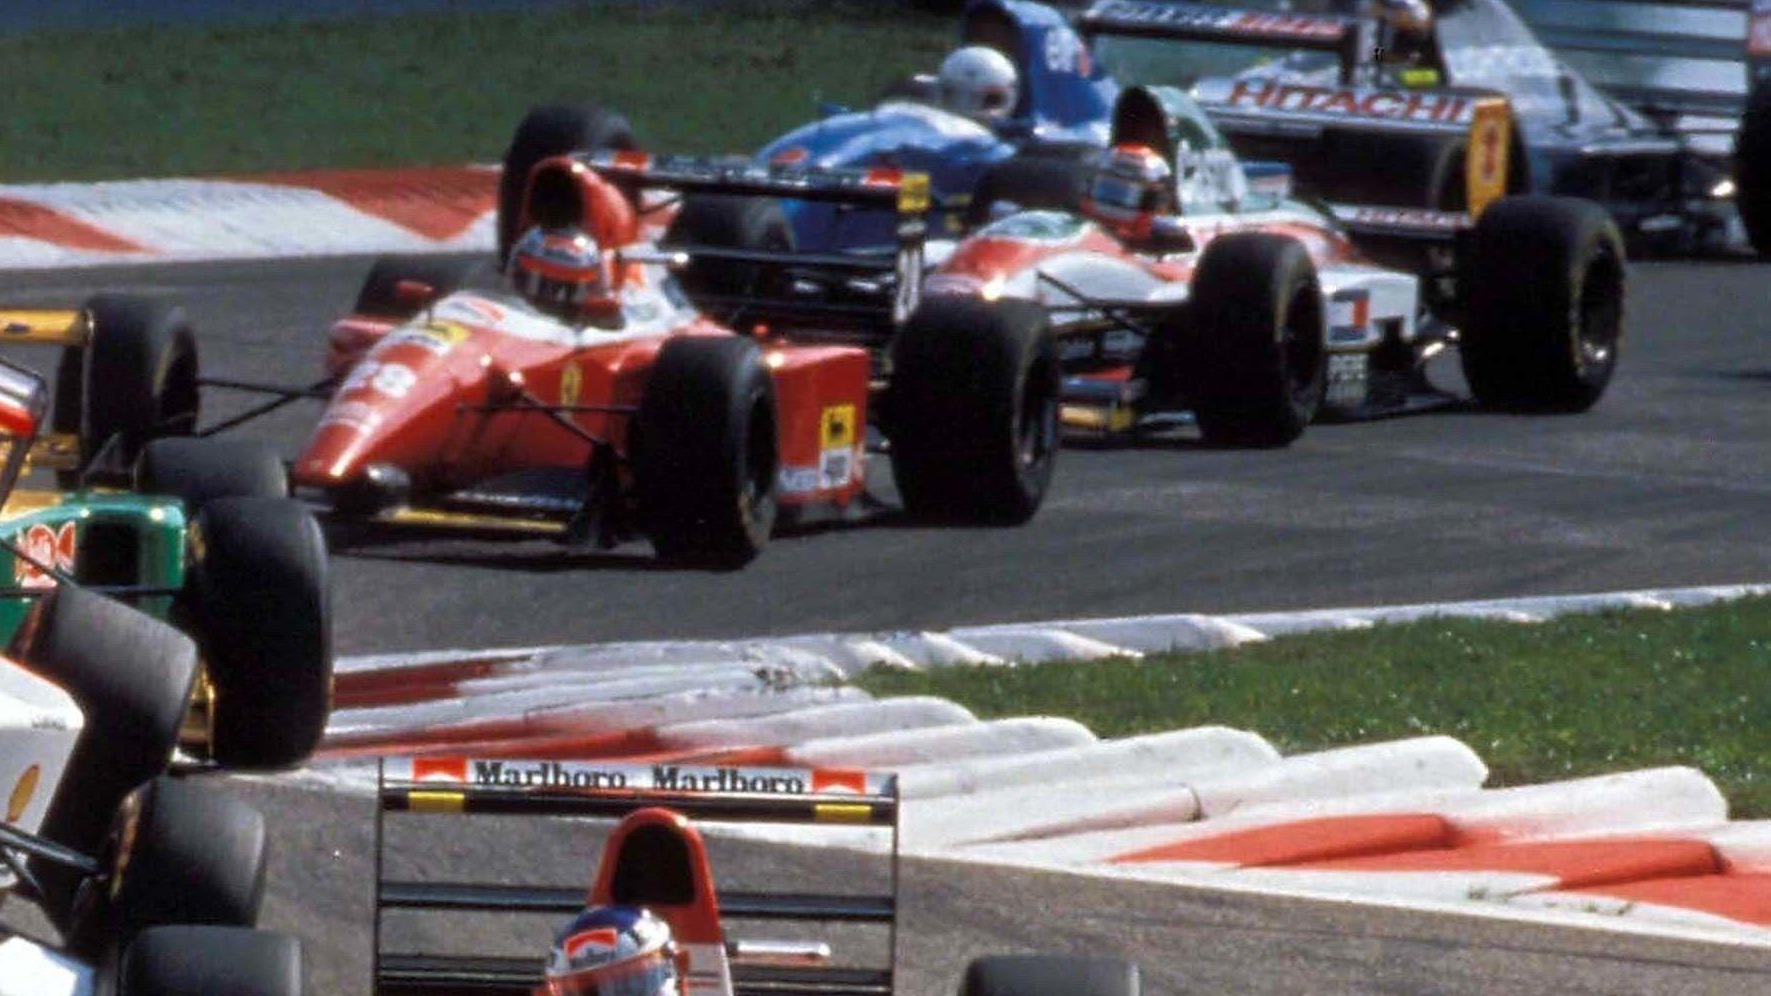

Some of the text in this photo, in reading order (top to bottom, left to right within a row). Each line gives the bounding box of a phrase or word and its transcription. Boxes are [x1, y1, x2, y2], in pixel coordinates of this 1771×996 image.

[1231, 80, 1466, 123] HITACHI
[474, 762, 804, 793] Marlboro Marlboro
